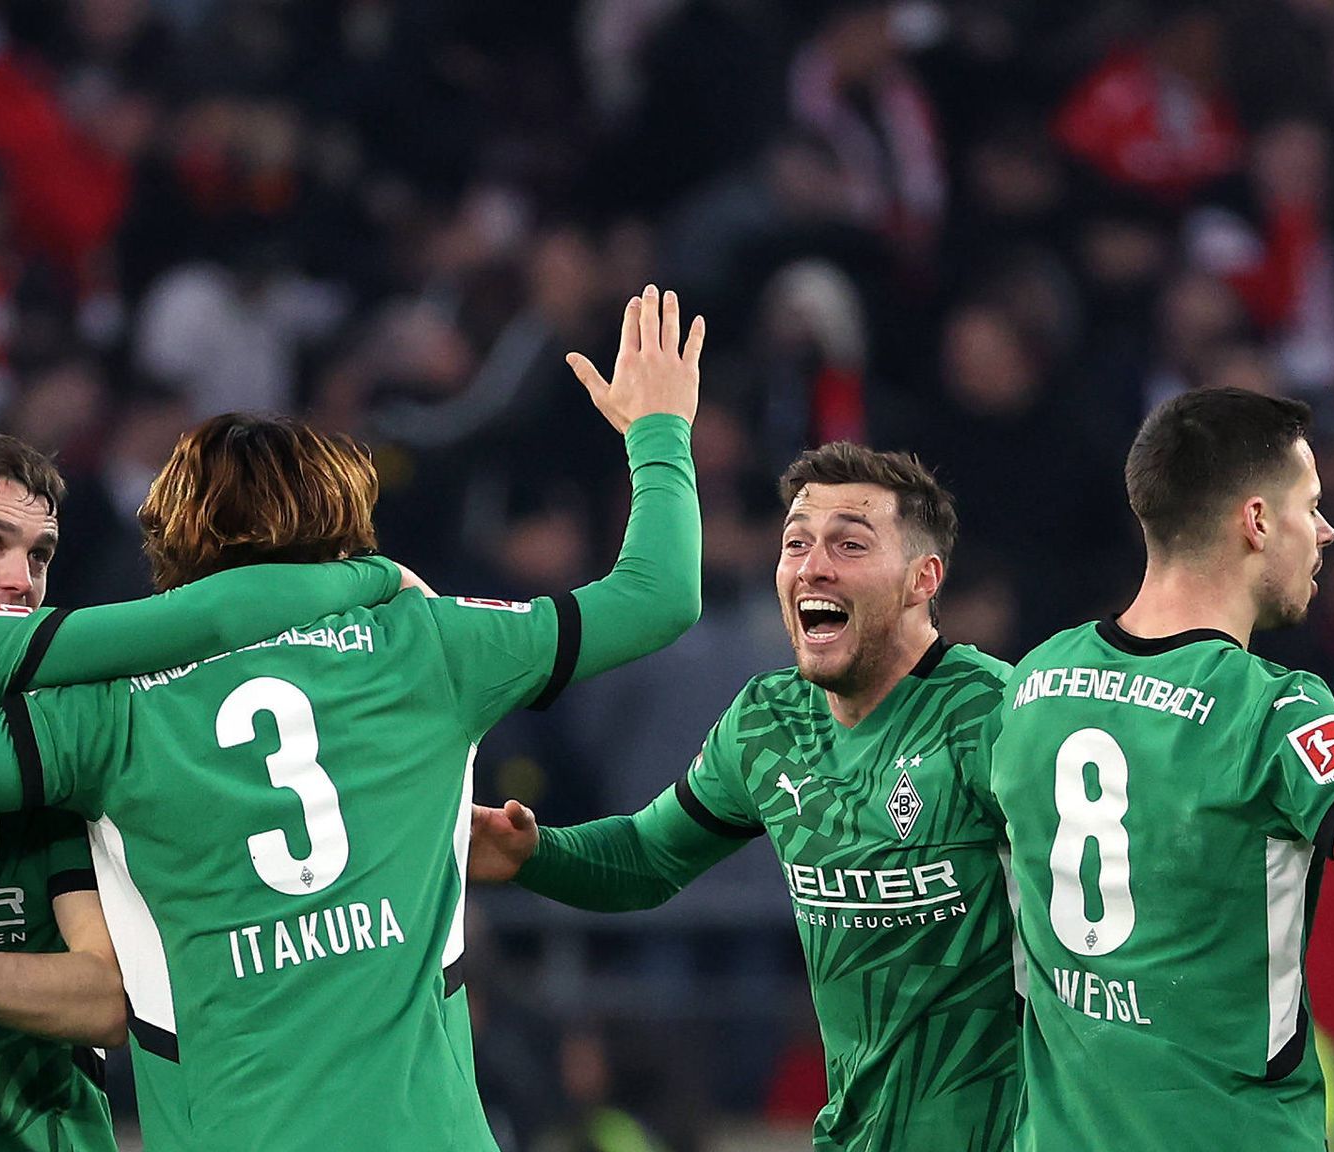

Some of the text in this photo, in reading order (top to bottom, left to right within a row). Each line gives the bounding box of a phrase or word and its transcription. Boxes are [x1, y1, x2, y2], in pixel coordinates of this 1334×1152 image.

[1012, 667, 1216, 726] MÖNCHENGLADBACH
[215, 676, 349, 896] 3
[1049, 727, 1136, 957] 8
[229, 898, 405, 979] ITAKURA
[842, 902, 967, 930] LEUCHTEN
[1053, 967, 1152, 1025] WEIGL
